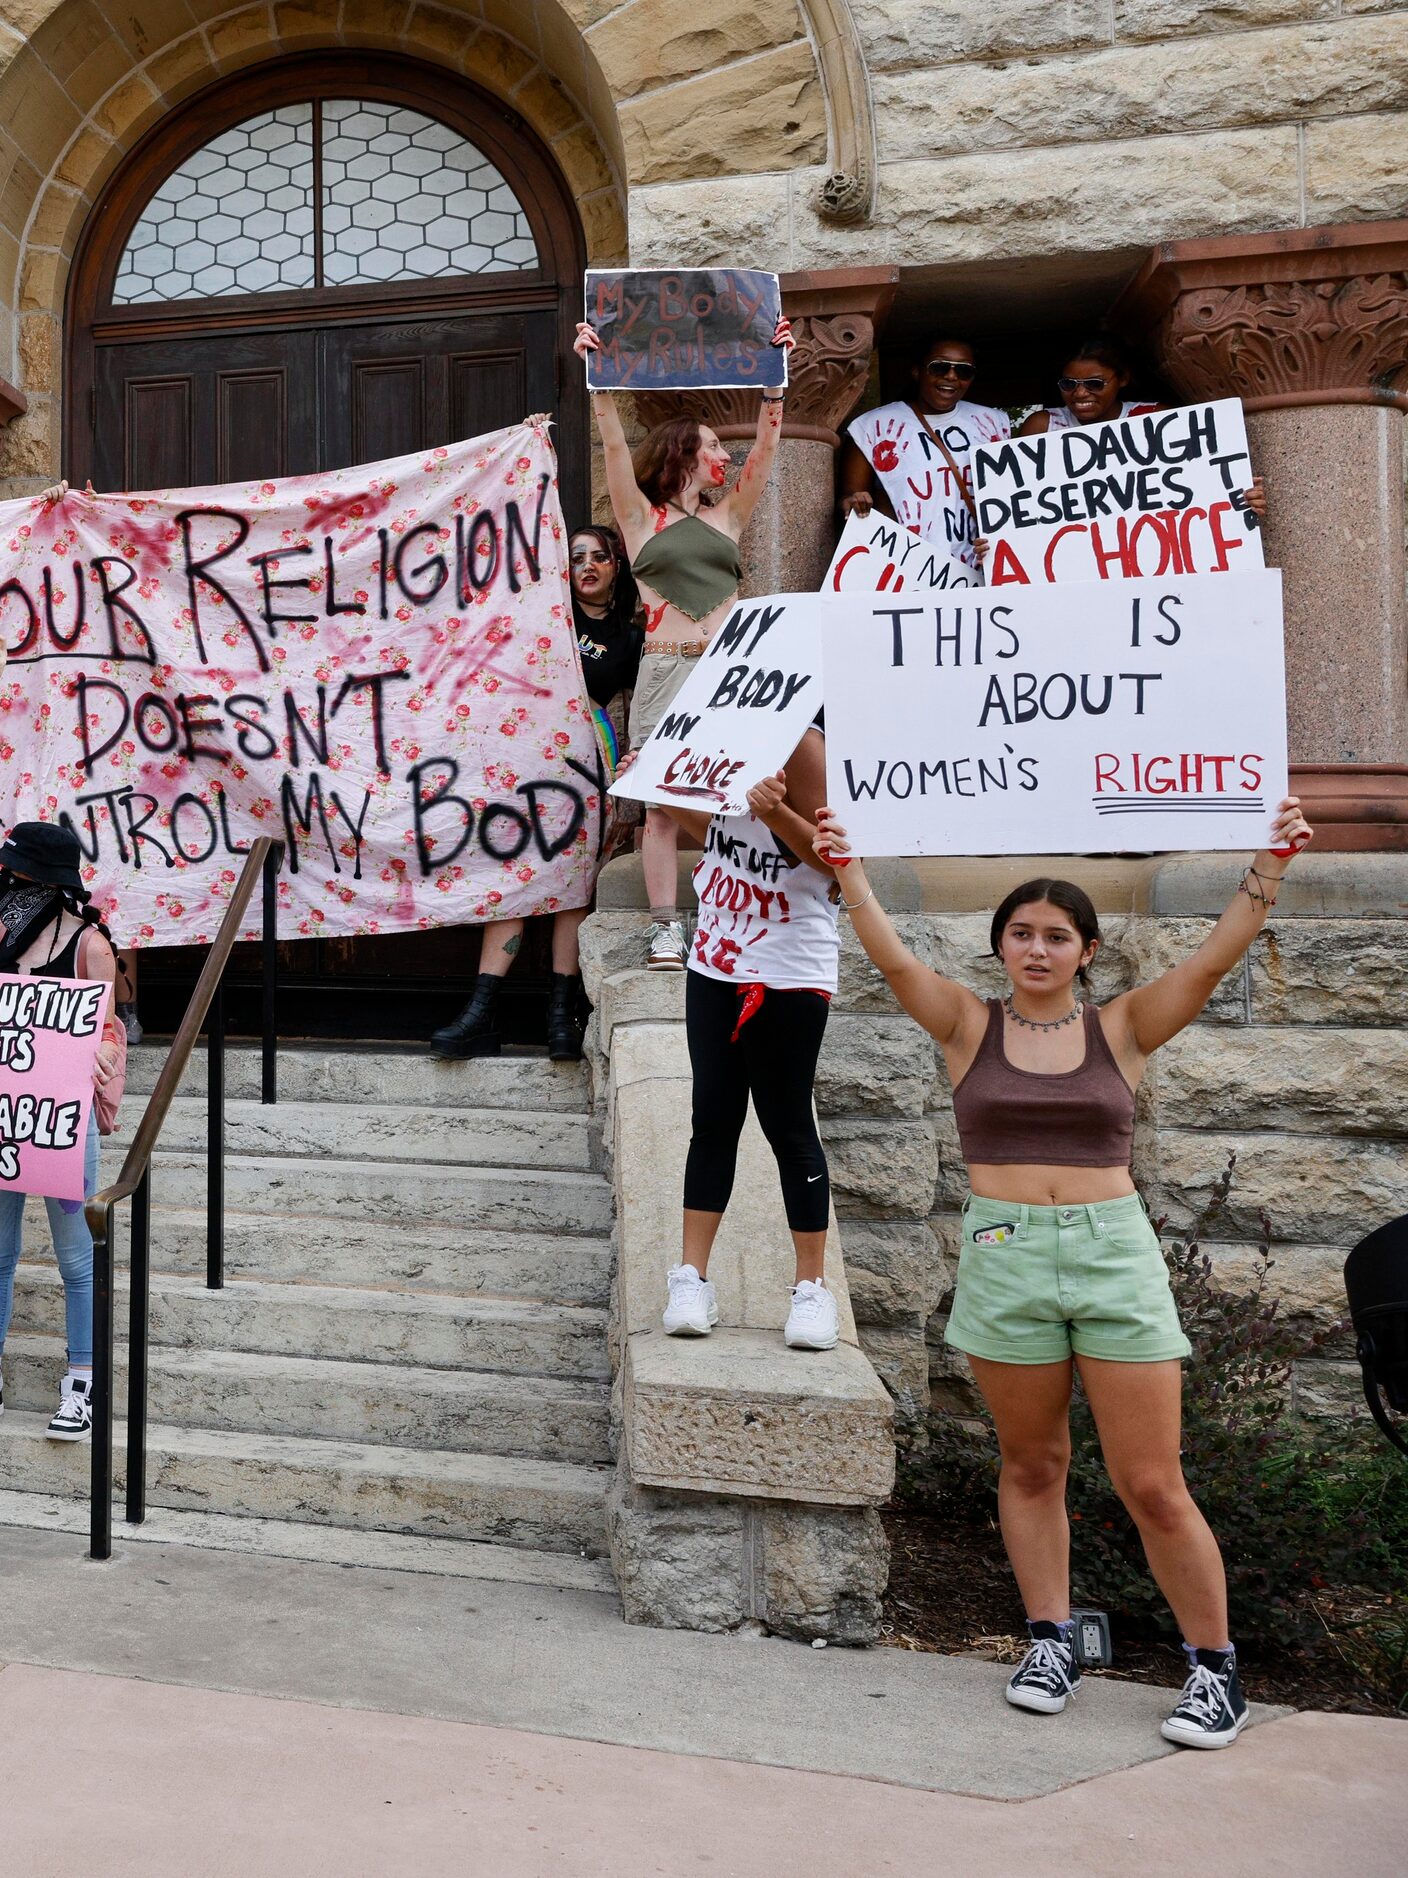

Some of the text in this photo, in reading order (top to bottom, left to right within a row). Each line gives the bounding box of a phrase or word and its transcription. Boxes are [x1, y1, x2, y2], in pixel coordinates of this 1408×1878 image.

[596, 274, 764, 336] My Body
[595, 323, 759, 385] My Rules
[918, 426, 970, 460] NO
[976, 408, 1218, 489] MY DAUGH
[980, 466, 1193, 534] DESERVES
[175, 474, 550, 673] RELIGION
[870, 526, 920, 566] MY
[991, 539, 1031, 586] A
[709, 605, 786, 658] MY
[872, 594, 1184, 667] THIS IS
[706, 664, 812, 712] BODY
[977, 672, 1163, 728] ABOUT
[75, 669, 410, 776] DOESN'T
[655, 712, 701, 741] MY
[664, 748, 746, 788] CHOICE
[843, 743, 1265, 801] WOMEN'S RIGHTS
[280, 772, 372, 881] MY
[747, 847, 790, 883] OFF
